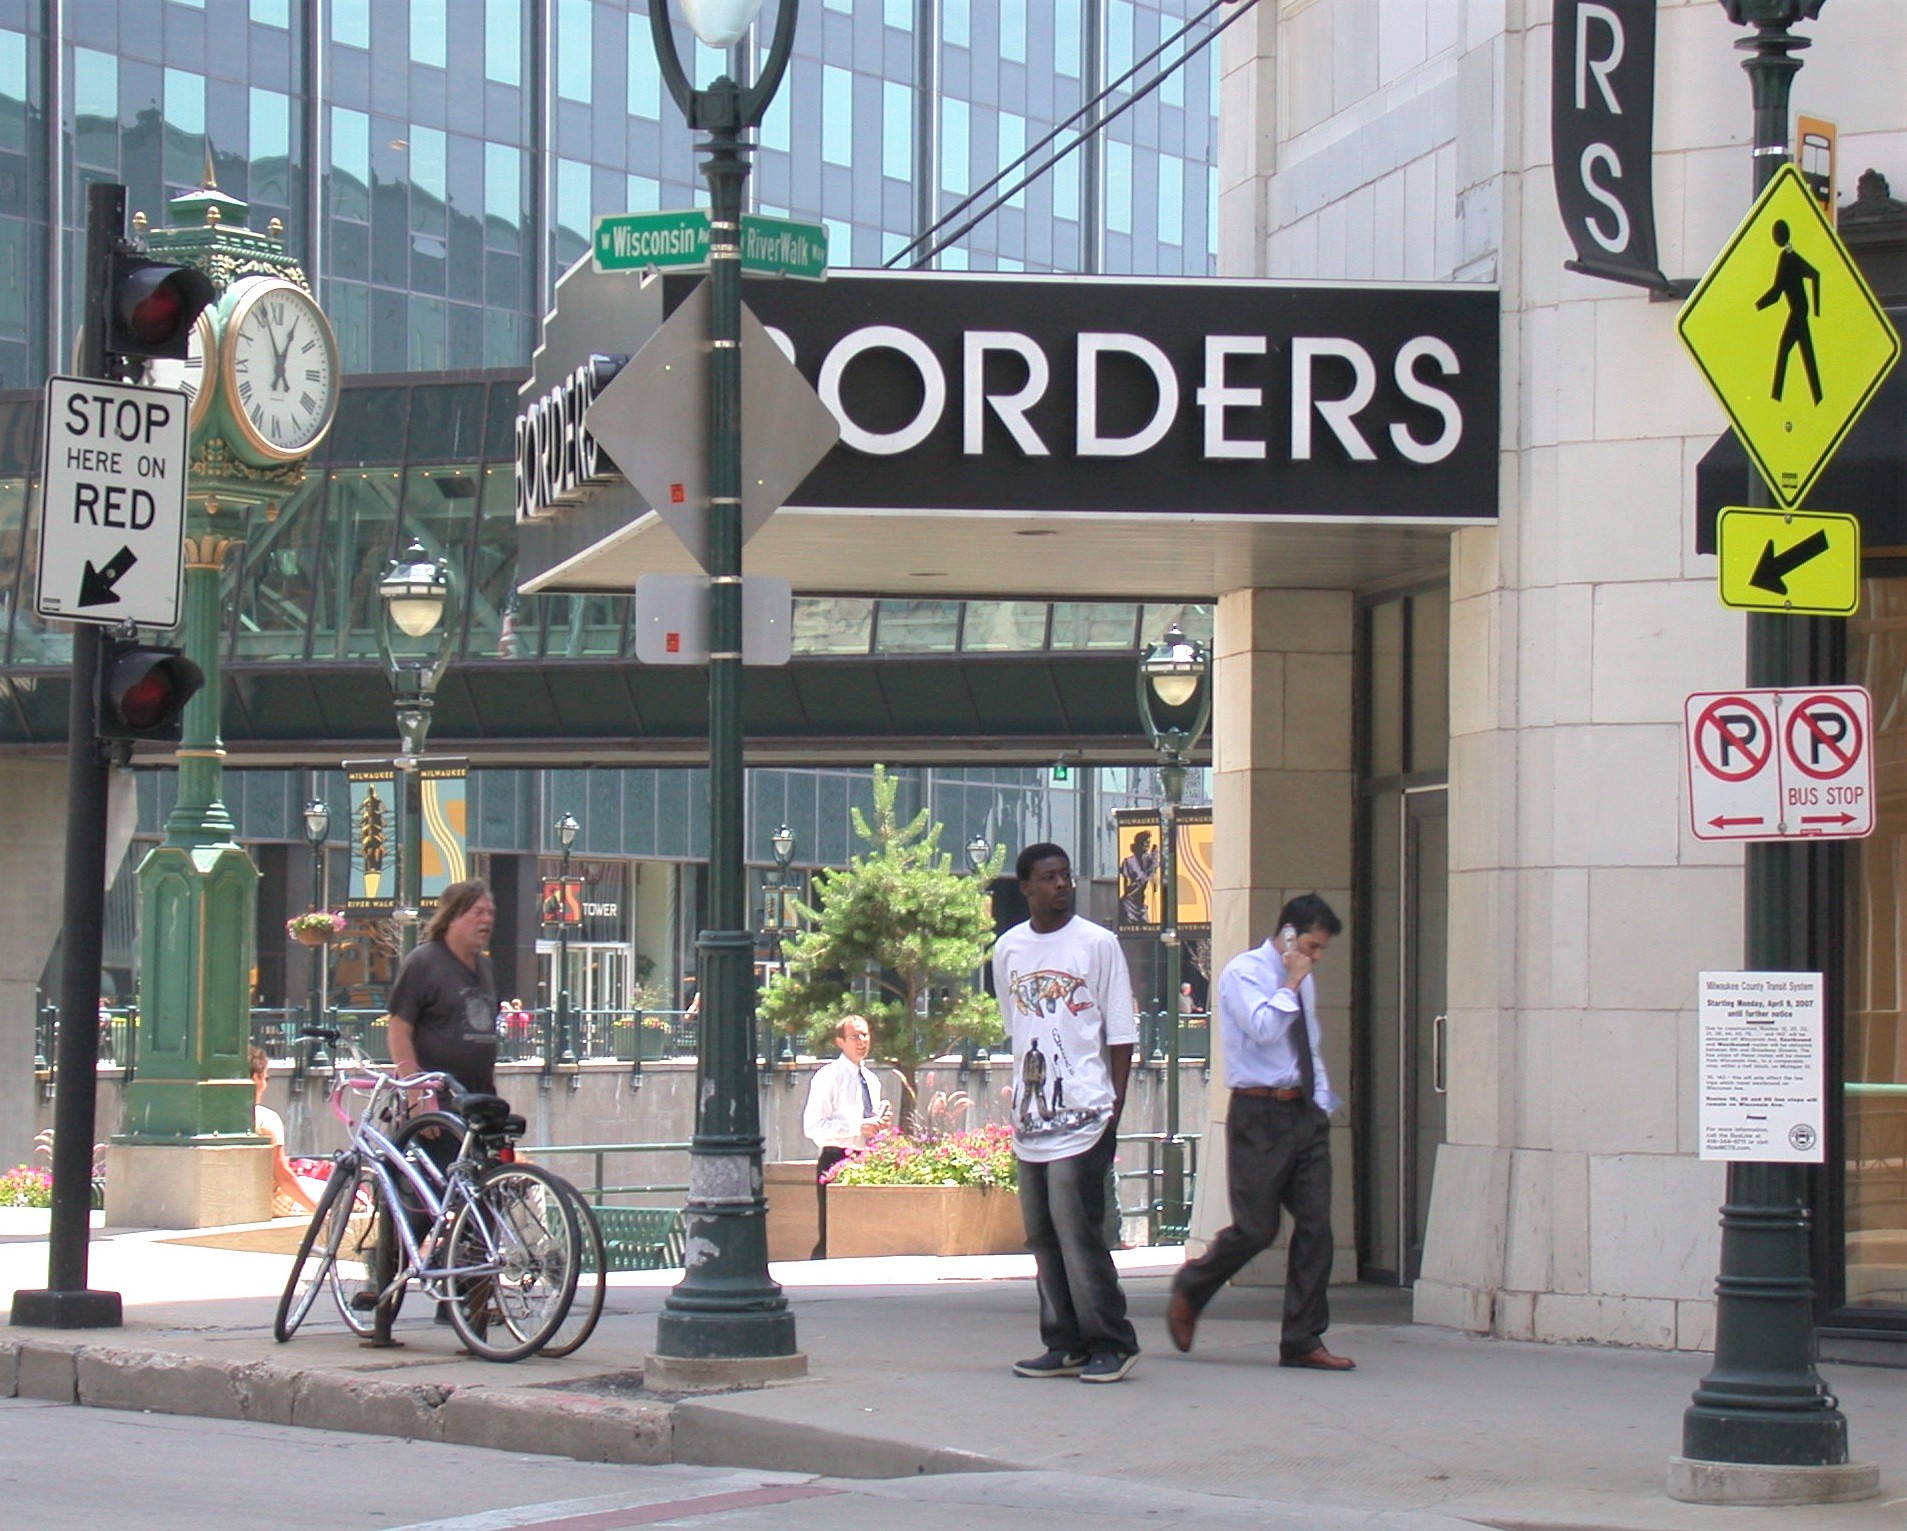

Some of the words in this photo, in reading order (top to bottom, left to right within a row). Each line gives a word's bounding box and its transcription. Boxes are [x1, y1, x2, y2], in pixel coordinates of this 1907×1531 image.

[601, 233, 611, 250] W
[613, 221, 695, 258] Wisconsin
[747, 227, 808, 266] RiverWalk
[762, 323, 1464, 465] ORDERS
[65, 392, 170, 443] STOP
[67, 447, 122, 474] HERE
[137, 455, 166, 479] ON
[74, 482, 156, 531] RED
[349, 771, 394, 780] MILWAUKEE
[420, 768, 466, 778] MILWAUKEE
[1788, 787, 1818, 806] BUS
[1827, 786, 1864, 805] STOP
[582, 902, 617, 917] TOWER
[1706, 982, 1739, 990] Milwaukee
[1741, 982, 1764, 991] County
[1766, 982, 1787, 990] Transit
[1789, 982, 1813, 991] System
[1737, 1000, 1765, 1008] Monday,
[1767, 1000, 1784, 1008] April
